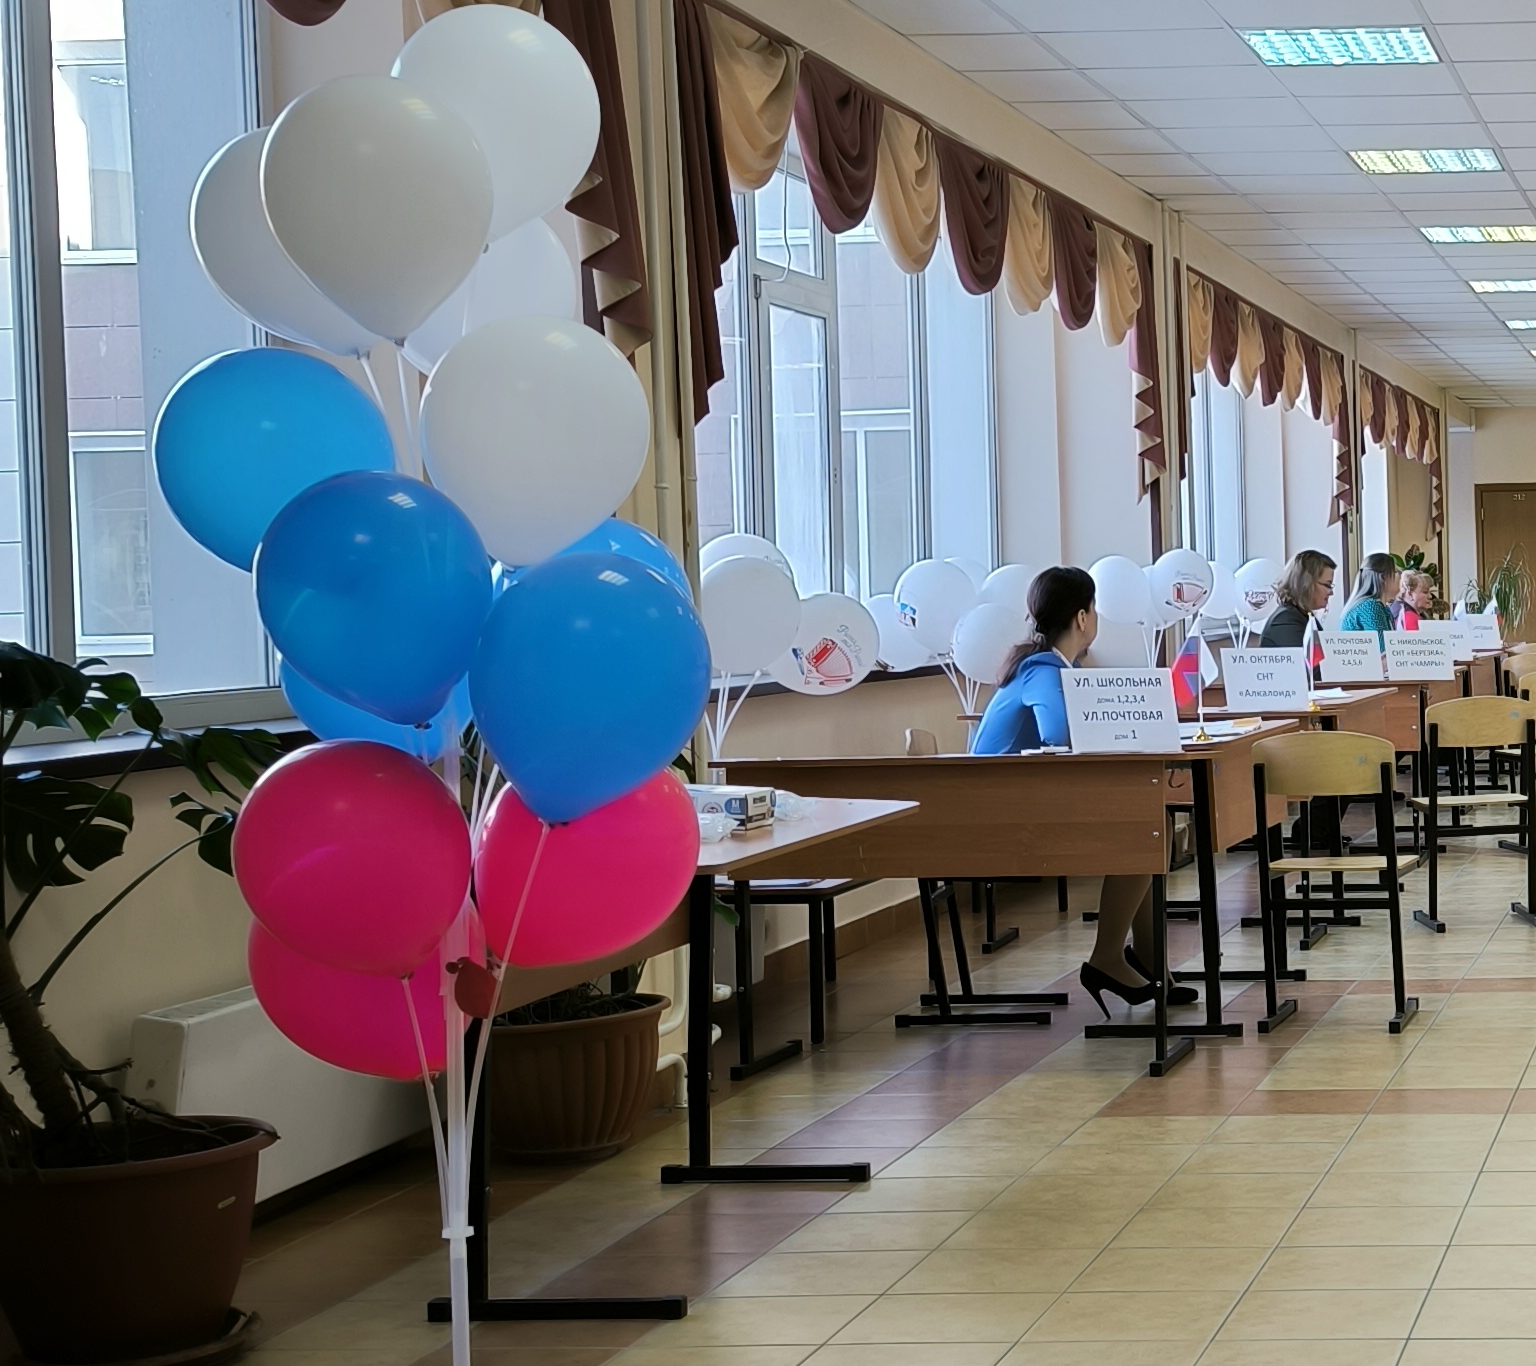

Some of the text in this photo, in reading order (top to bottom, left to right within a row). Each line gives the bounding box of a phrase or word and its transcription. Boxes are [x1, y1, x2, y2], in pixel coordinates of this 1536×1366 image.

[1231, 655, 1295, 665] УЛ. ОКТЯБРЯ,
[1256, 673, 1274, 681] СНТ
[1074, 677, 1162, 688] УЛ. ШКОЛЬНАЯ
[1239, 689, 1296, 698] «Алкалоид»
[1117, 695, 1146, 704] 1,2,3,4
[1131, 729, 1138, 740] 1
